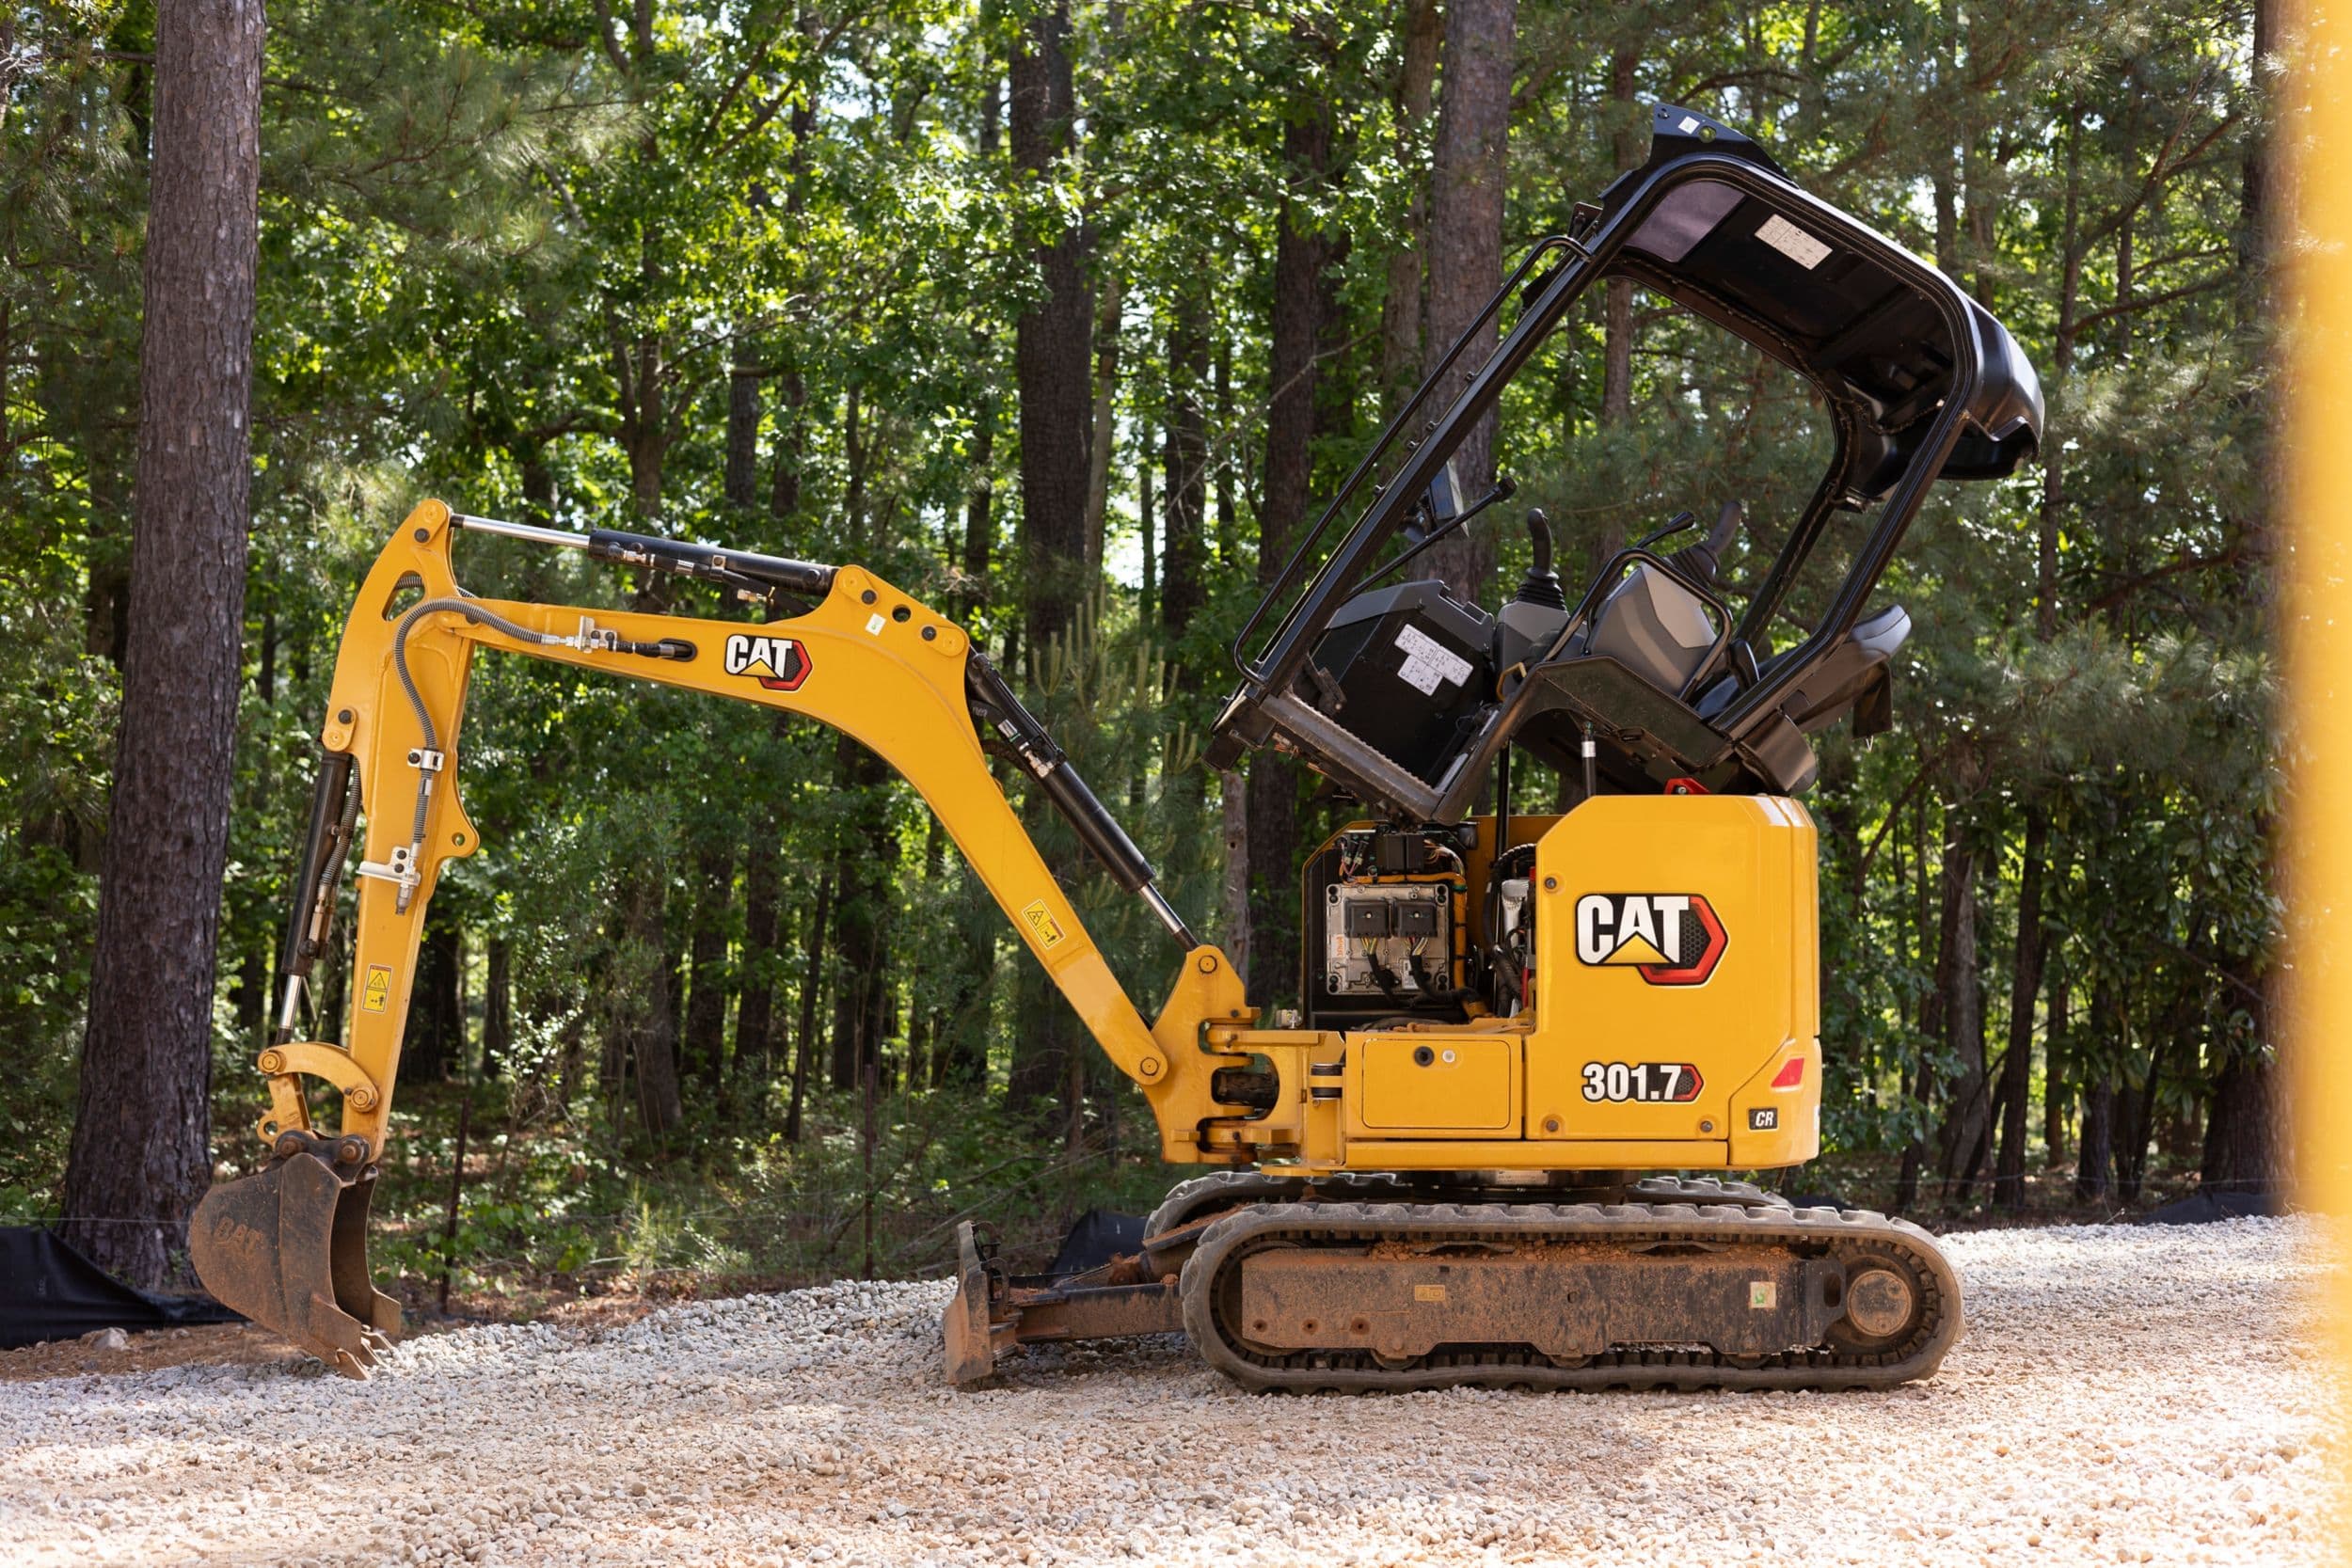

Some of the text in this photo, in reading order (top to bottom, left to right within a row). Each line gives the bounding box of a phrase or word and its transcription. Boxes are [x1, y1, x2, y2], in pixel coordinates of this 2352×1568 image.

[725, 635, 793, 678] CAT
[1578, 895, 1689, 963] CAT
[1583, 1063, 1681, 1101] 301.7
[1756, 1111, 1774, 1127] CR
